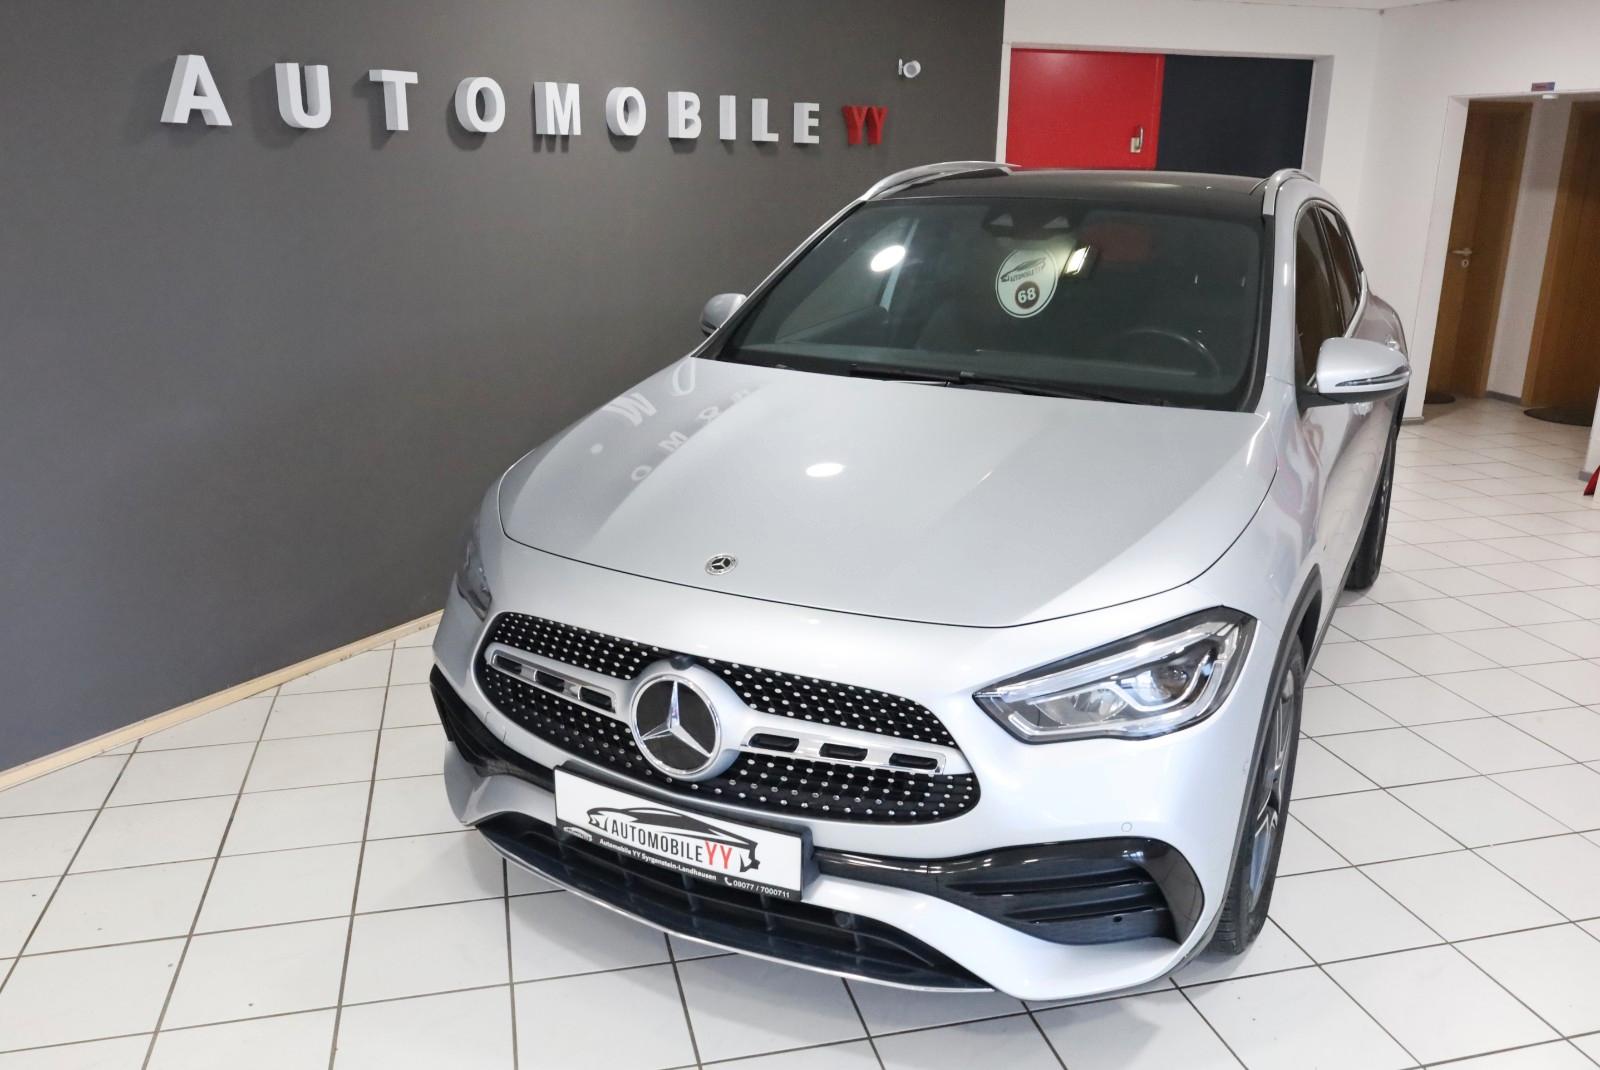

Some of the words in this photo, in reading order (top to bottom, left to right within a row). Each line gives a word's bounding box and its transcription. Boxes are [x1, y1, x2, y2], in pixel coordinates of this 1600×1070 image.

[160, 54, 820, 144] AUTOMOBILE
[842, 104, 888, 145] YY
[1017, 287, 1037, 304] 68
[600, 838, 632, 855] Automobile
[632, 849, 641, 858] YY
[760, 886, 790, 899] 7000711
